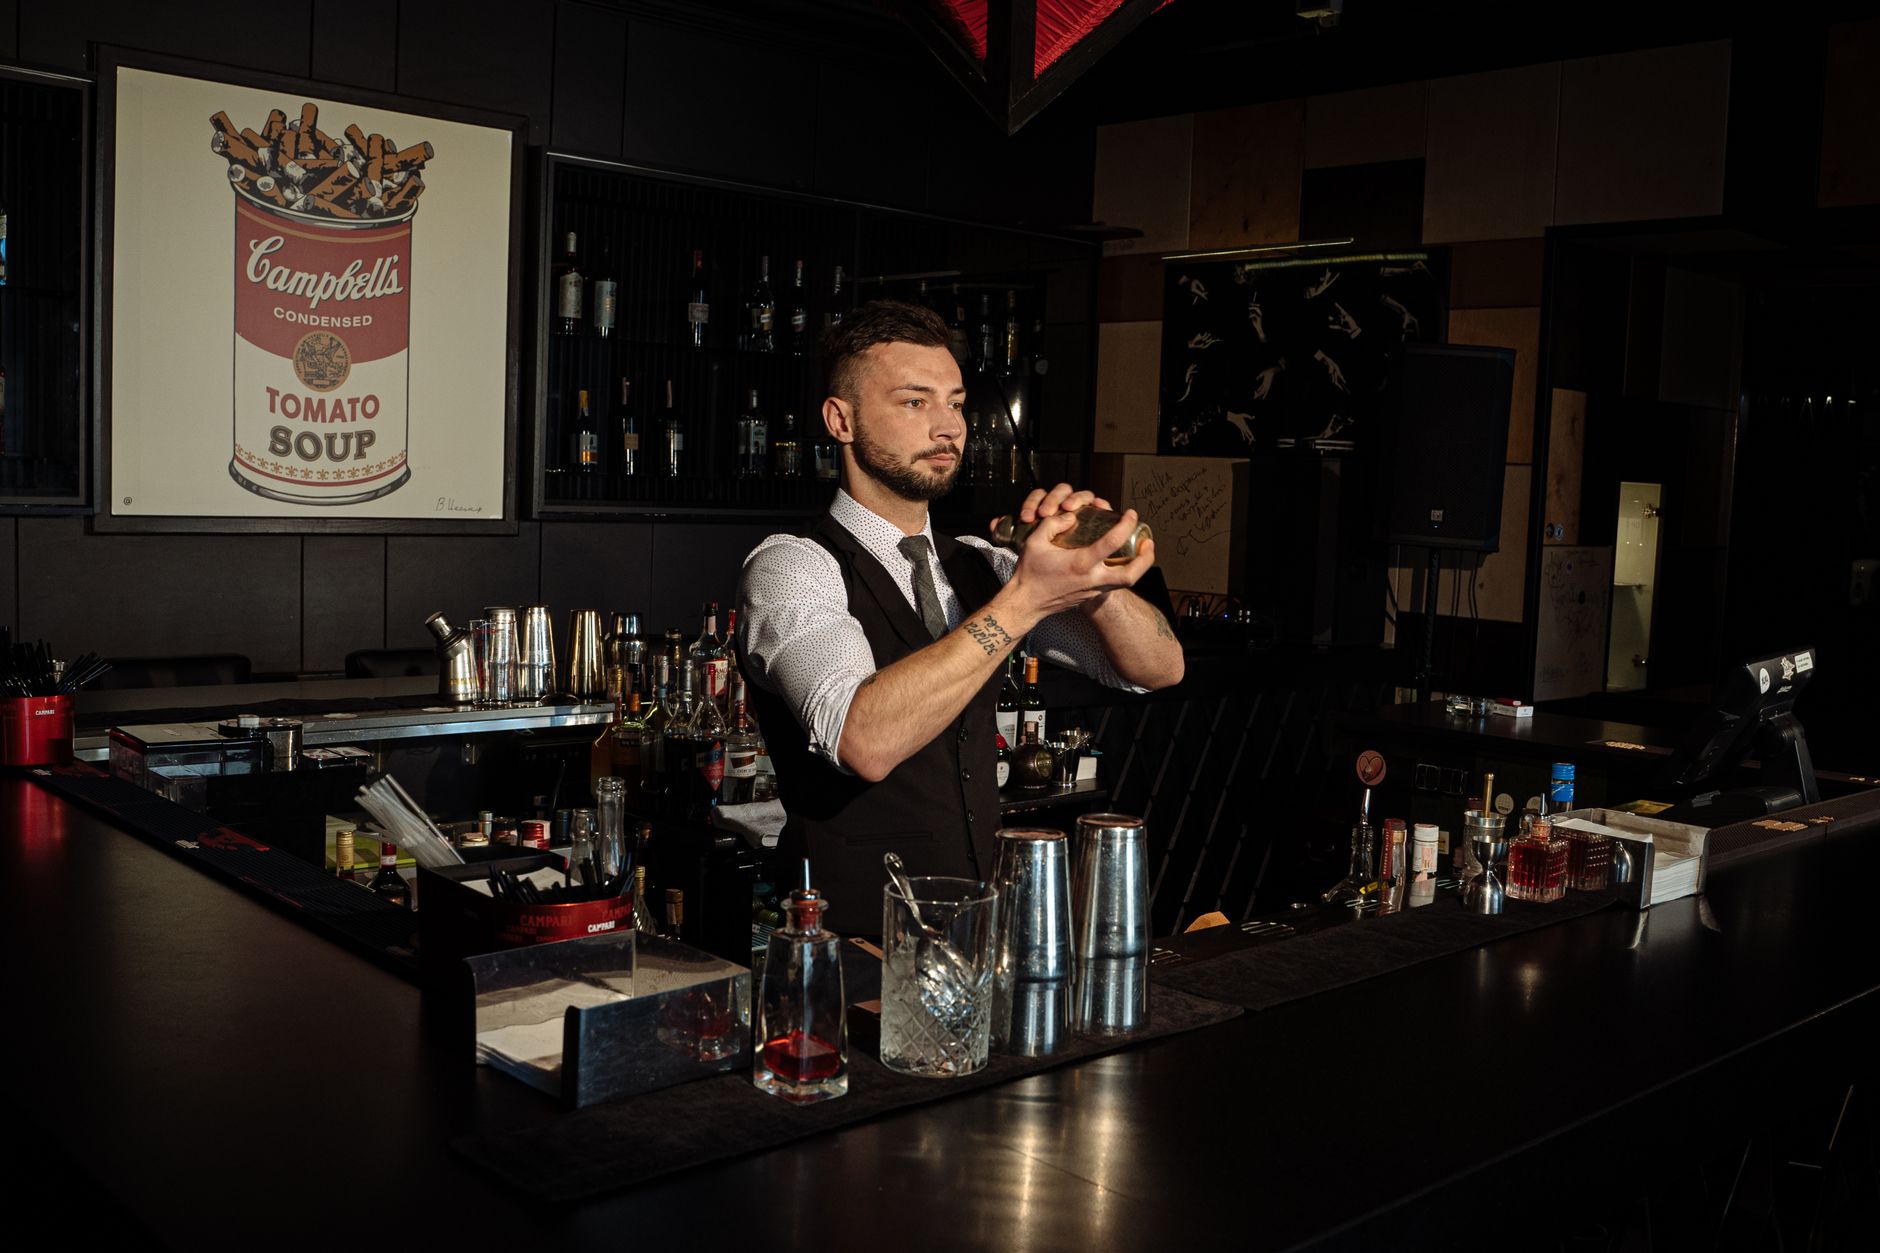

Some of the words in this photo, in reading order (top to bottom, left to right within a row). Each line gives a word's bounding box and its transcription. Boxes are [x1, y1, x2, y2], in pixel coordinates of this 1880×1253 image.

[246, 236, 403, 309] Campbell's
[273, 307, 373, 328] CONDENSED
[265, 386, 380, 423] TOMATO
[268, 425, 376, 462] SOUP
[519, 914, 573, 928] CAMPARI
[587, 920, 615, 933] CAMPARI
